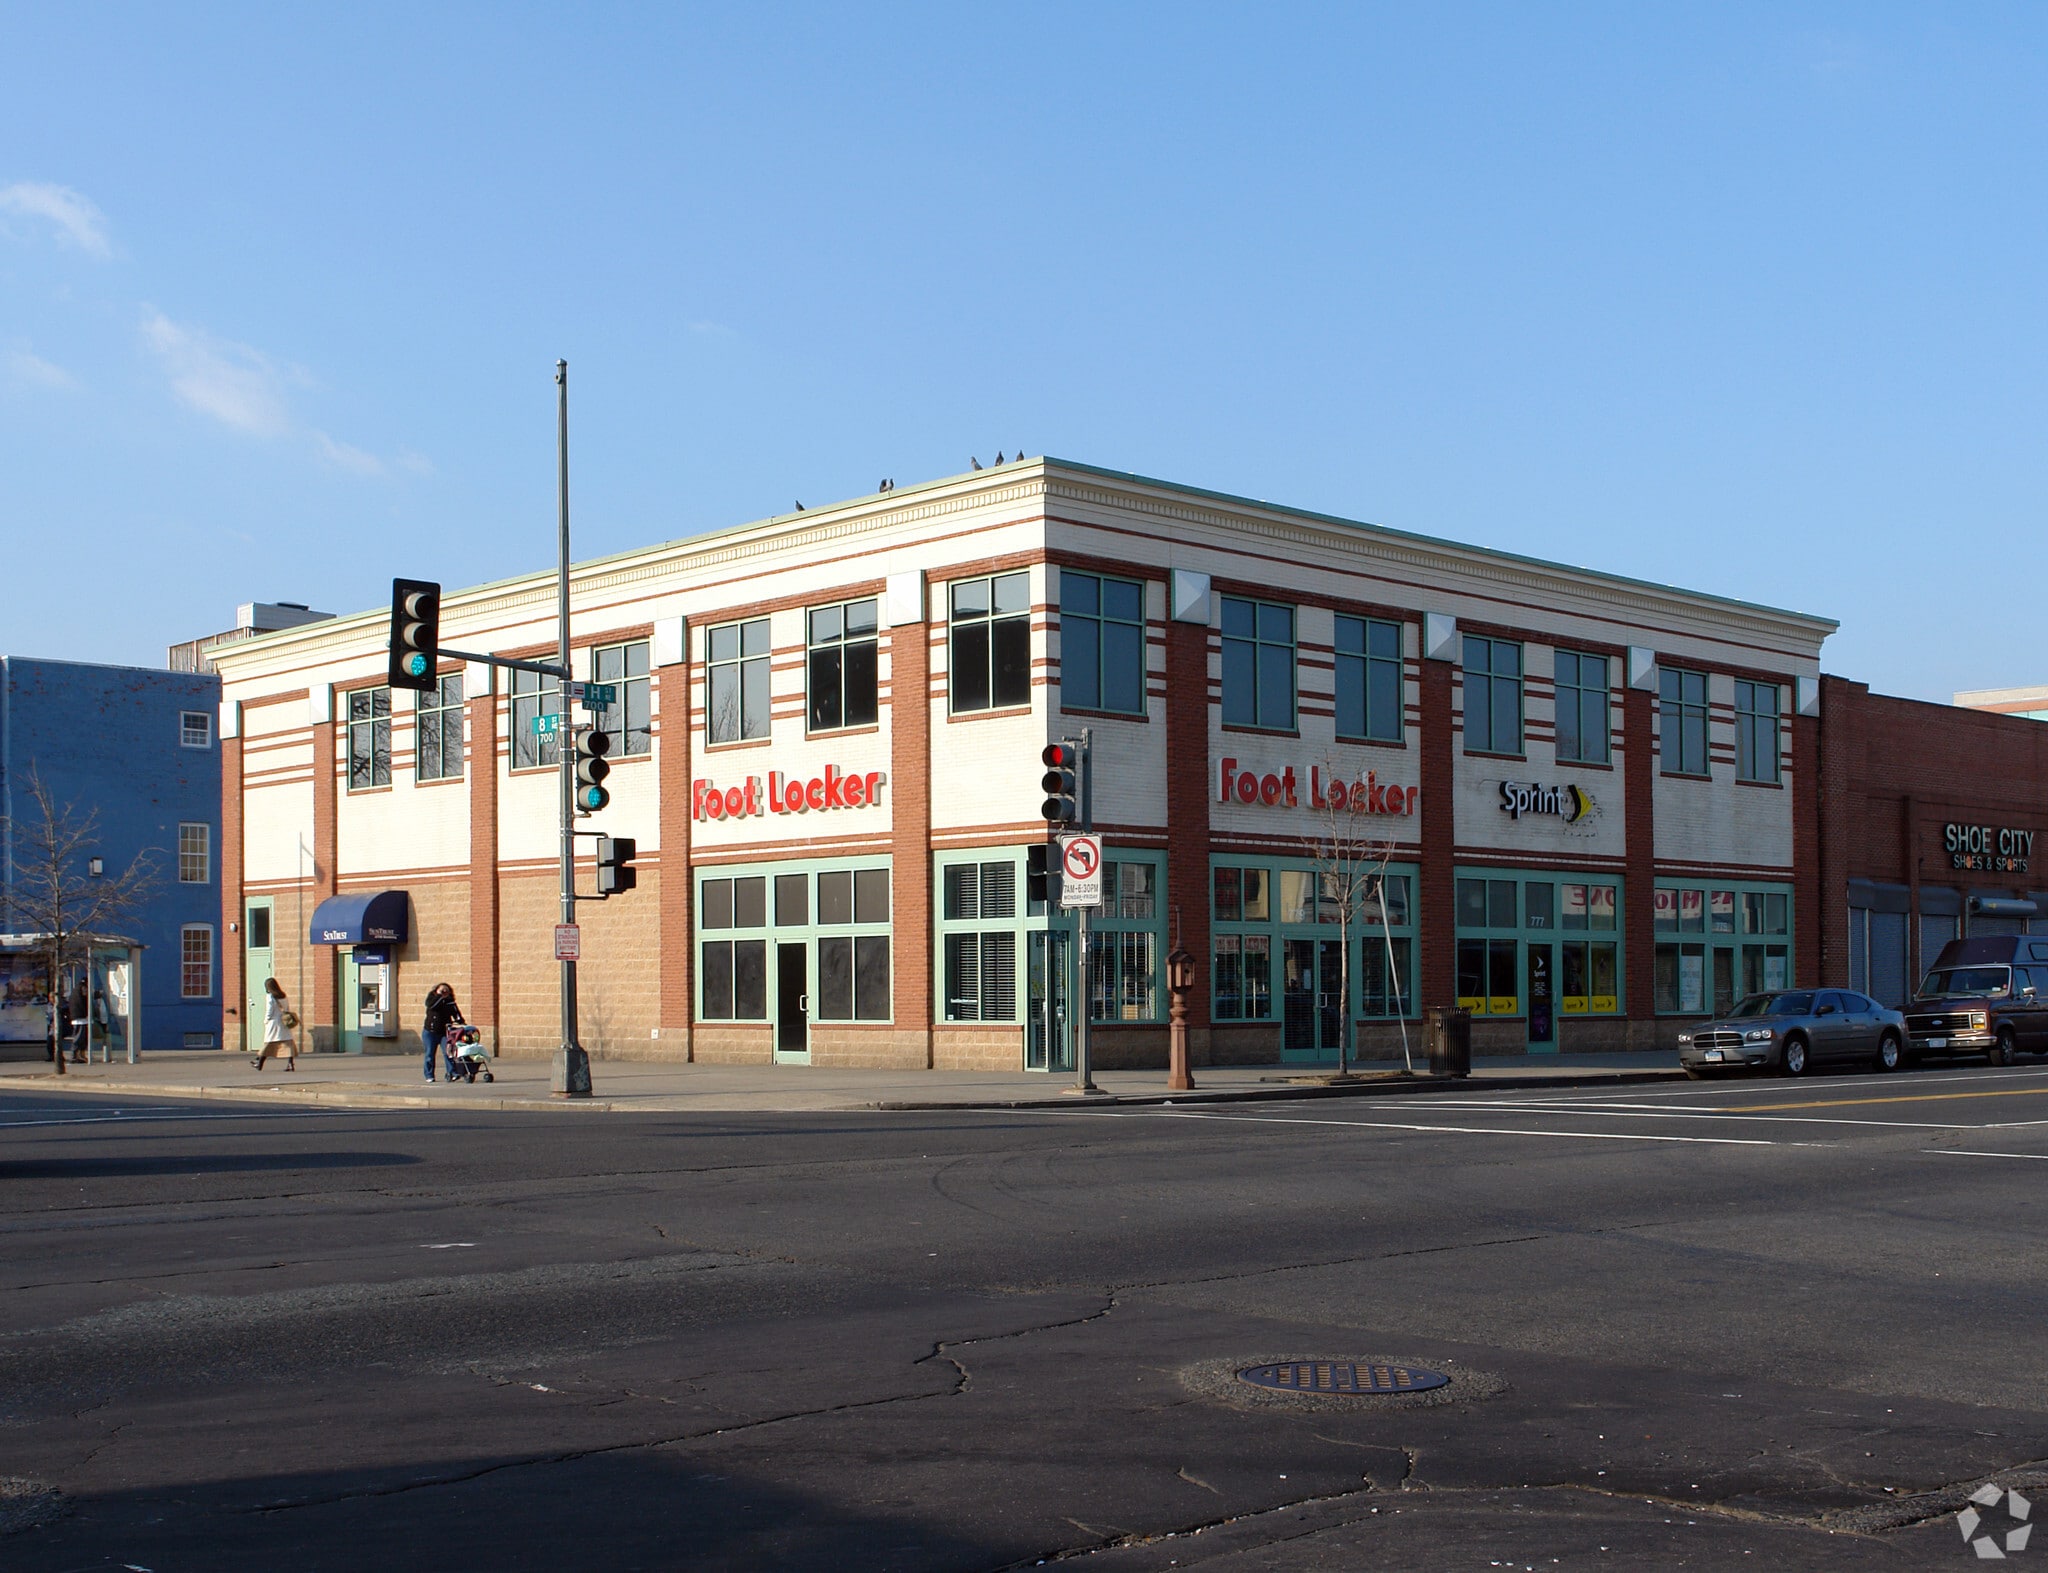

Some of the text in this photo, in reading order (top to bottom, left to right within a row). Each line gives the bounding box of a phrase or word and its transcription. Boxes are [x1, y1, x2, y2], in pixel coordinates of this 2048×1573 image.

[591, 685, 600, 699] H
[584, 700, 604, 710] 700
[539, 718, 545, 732] 8
[540, 732, 553, 743] 700
[692, 764, 886, 822] Foot Locker
[1216, 757, 1418, 816] Foot Locker
[1501, 780, 1564, 819] Sprint
[1946, 824, 2034, 856] SHOE CITY
[1953, 854, 2028, 873] SHOES & SPORTS
[1530, 916, 1544, 927] 777
